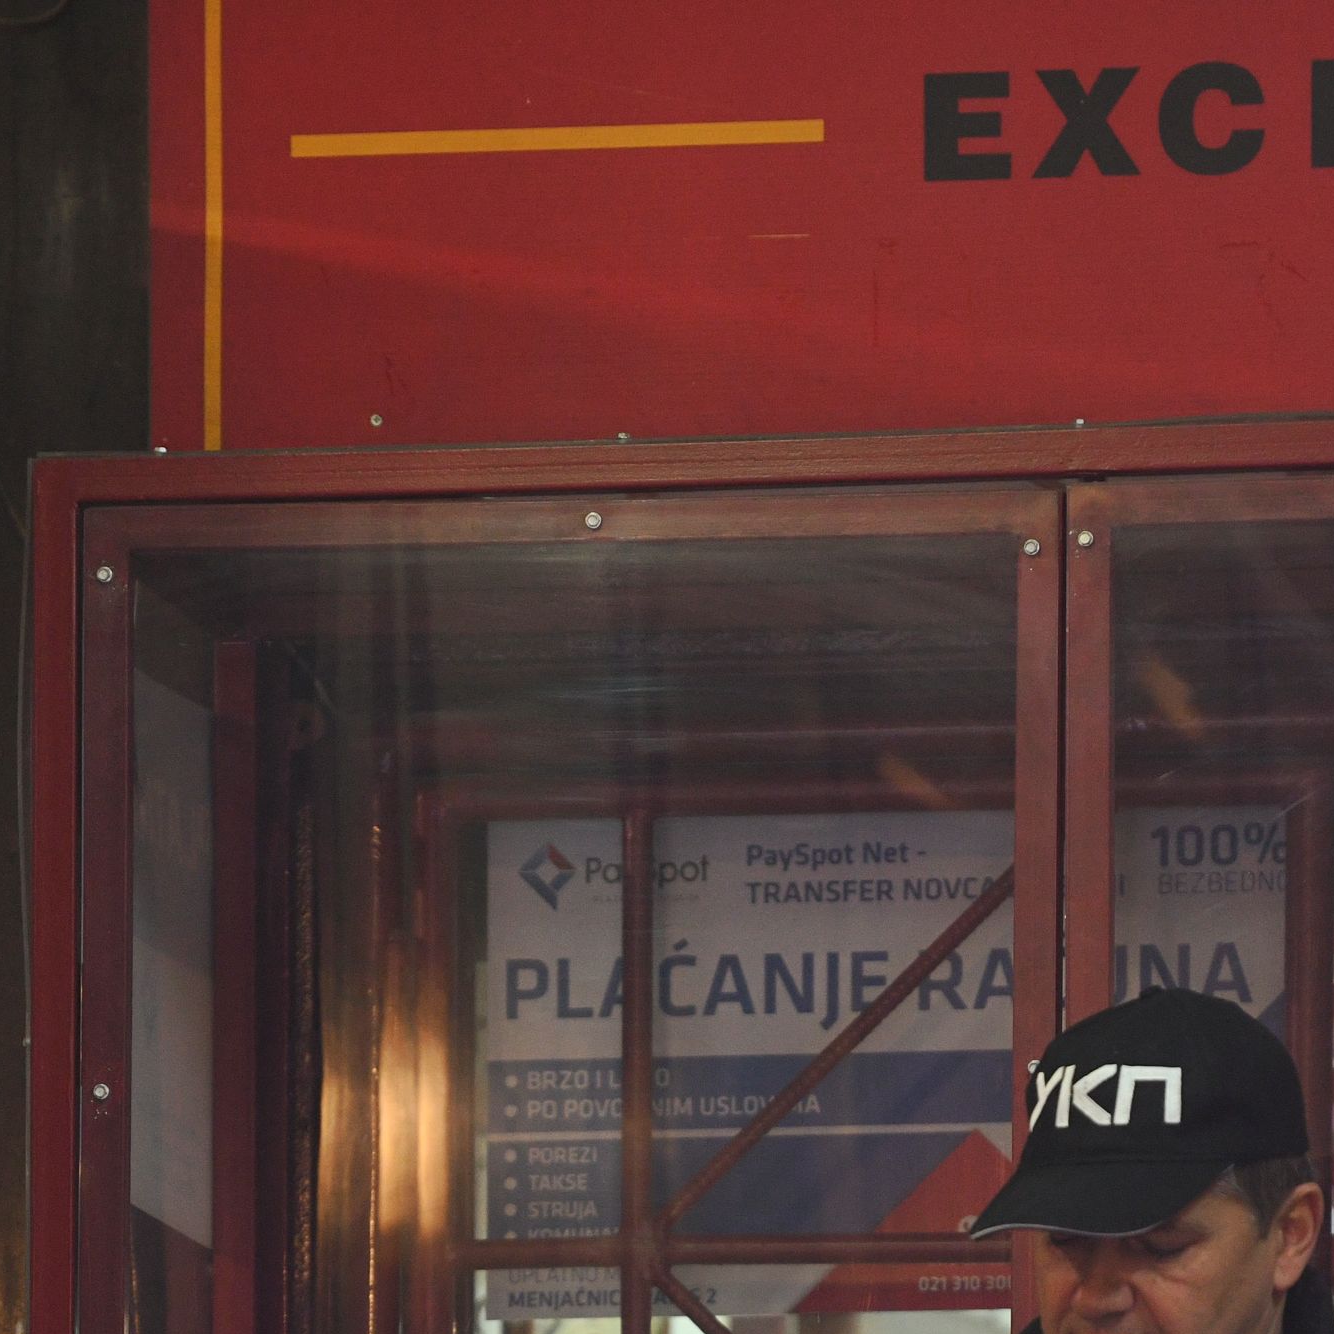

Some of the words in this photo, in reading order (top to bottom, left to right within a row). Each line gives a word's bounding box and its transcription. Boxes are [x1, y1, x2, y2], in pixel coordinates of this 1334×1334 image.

[1151, 822, 1286, 867] 100%
[745, 843, 855, 870] PaySpot
[860, 841, 909, 863] Net
[747, 879, 894, 905] TRANSFER
[526, 1069, 589, 1090] BRZO
[595, 1070, 601, 1089] I
[526, 1099, 557, 1119] PO
[527, 1146, 598, 1165] POREZI
[527, 1173, 588, 1191] TAKSE
[526, 1200, 599, 1220] STRUJA
[918, 1276, 948, 1291] 021
[952, 1275, 981, 1291] 310
[507, 1287, 621, 1311] MENJAČNIC
[706, 1287, 717, 1304] 2
